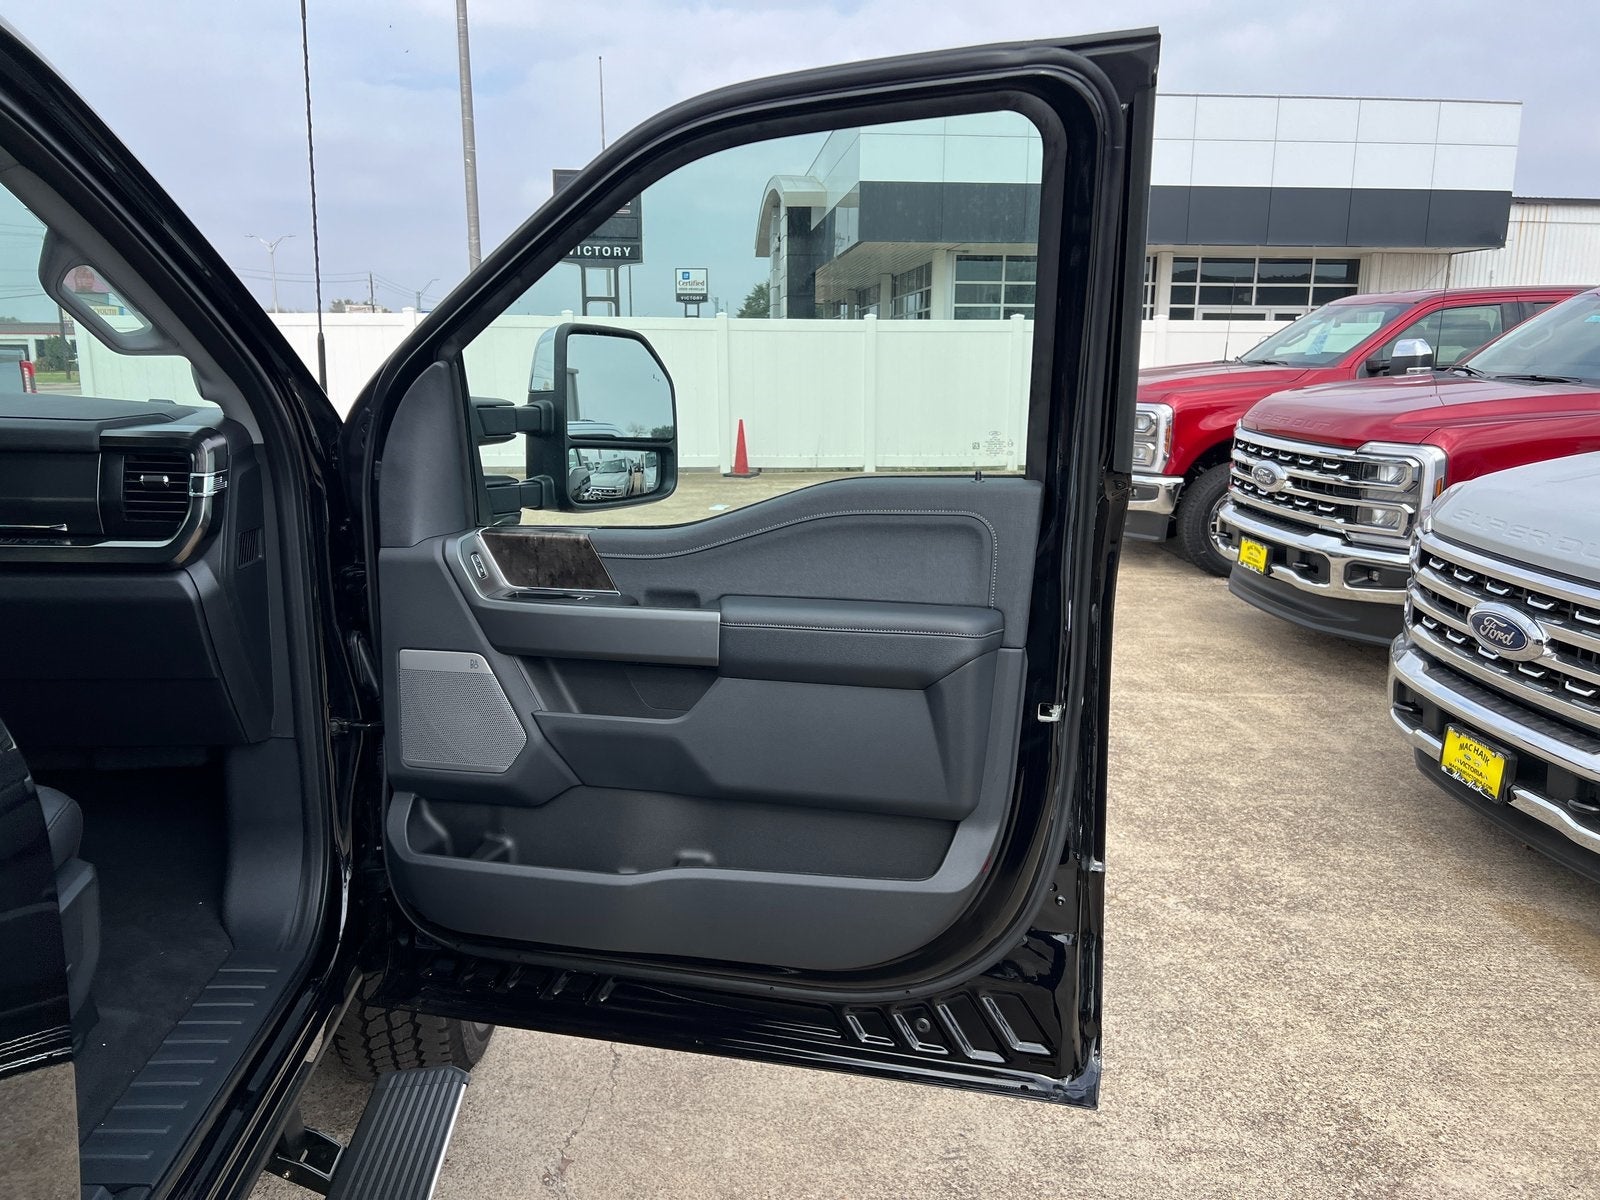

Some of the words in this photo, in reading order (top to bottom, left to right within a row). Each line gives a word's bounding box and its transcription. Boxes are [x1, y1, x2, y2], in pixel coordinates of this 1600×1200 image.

[1247, 411, 1292, 425] SUPER
[1291, 417, 1343, 432] DUTY
[1452, 507, 1552, 546] SUPER
[1479, 616, 1516, 646] Ford
[1459, 743, 1473, 751] MAC
[1473, 746, 1490, 766] HAIK
[1460, 759, 1484, 778] VICTORIA
